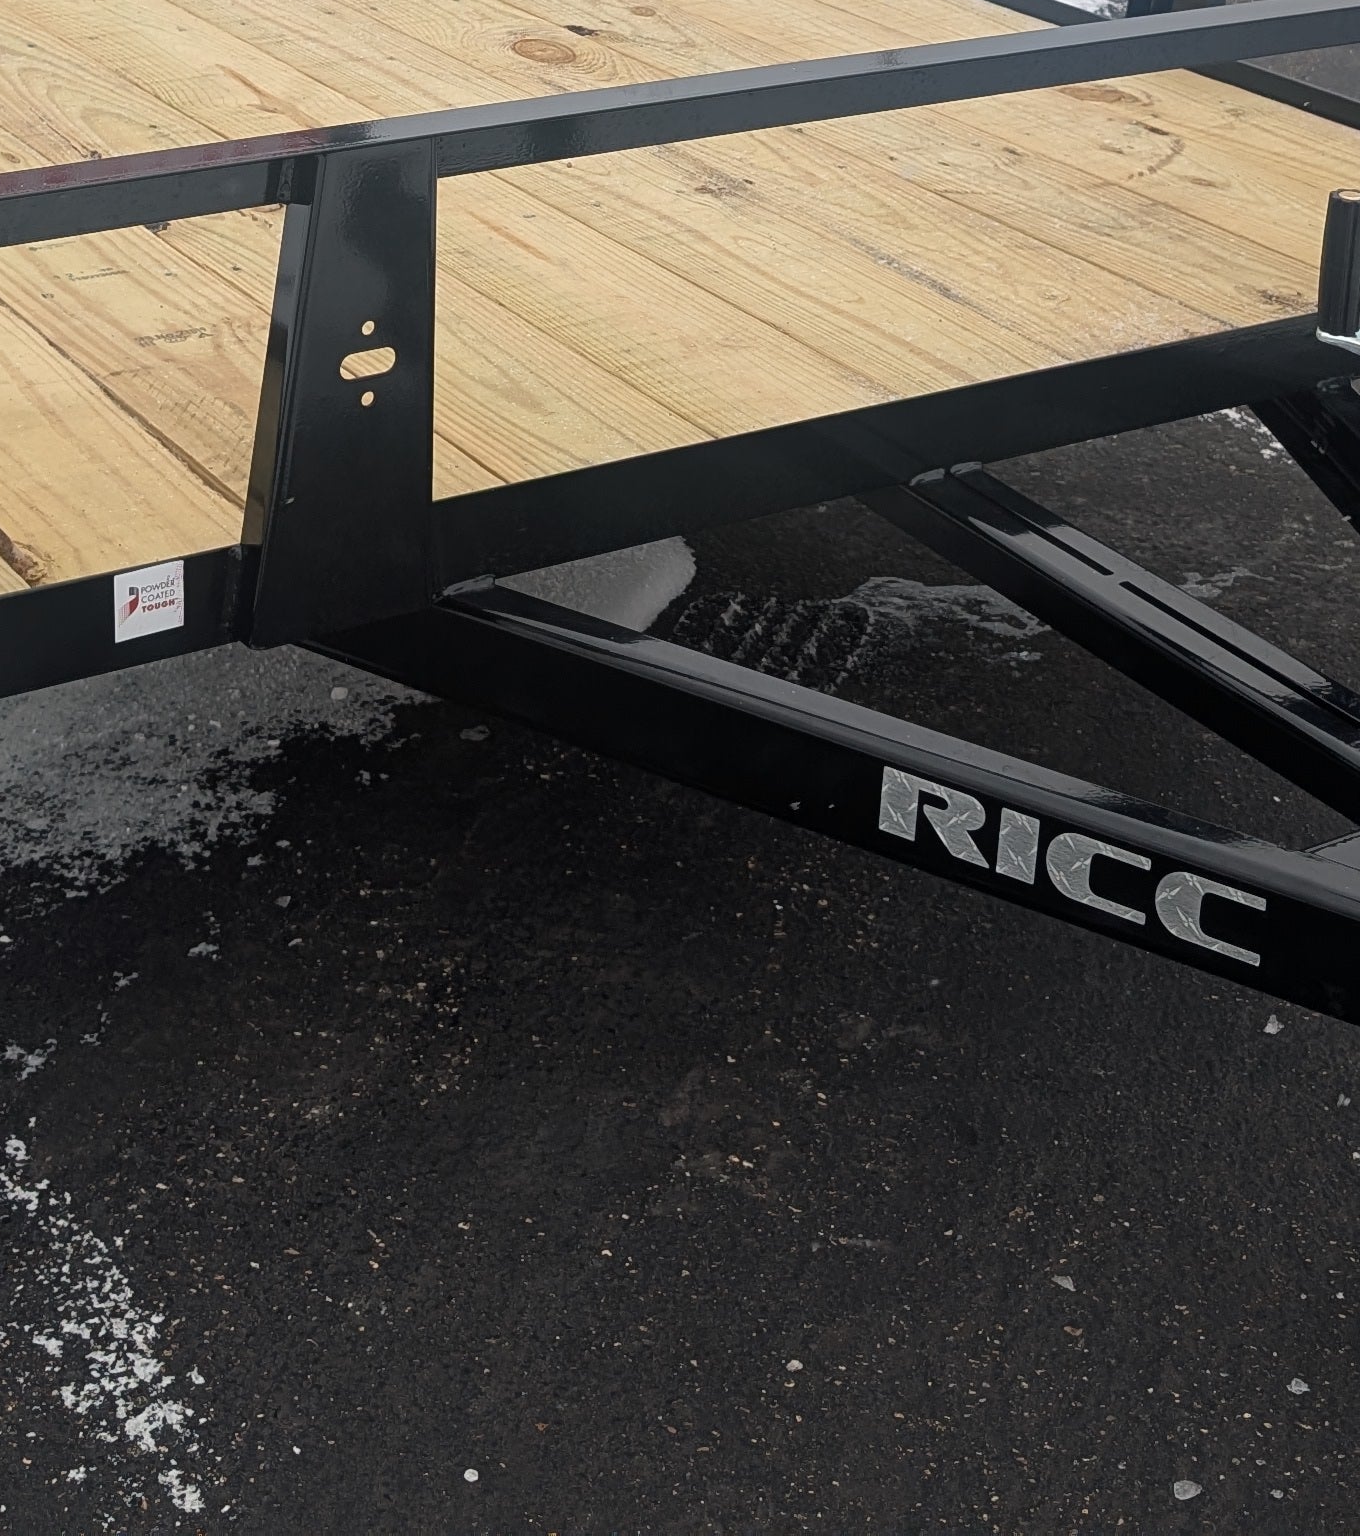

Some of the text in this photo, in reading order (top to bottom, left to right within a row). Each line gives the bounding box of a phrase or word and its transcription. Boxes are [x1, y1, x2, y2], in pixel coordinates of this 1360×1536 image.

[141, 578, 175, 594] POWDER
[141, 589, 176, 603] COATED
[141, 599, 176, 613] TOUGH
[879, 765, 1268, 966] RICC
